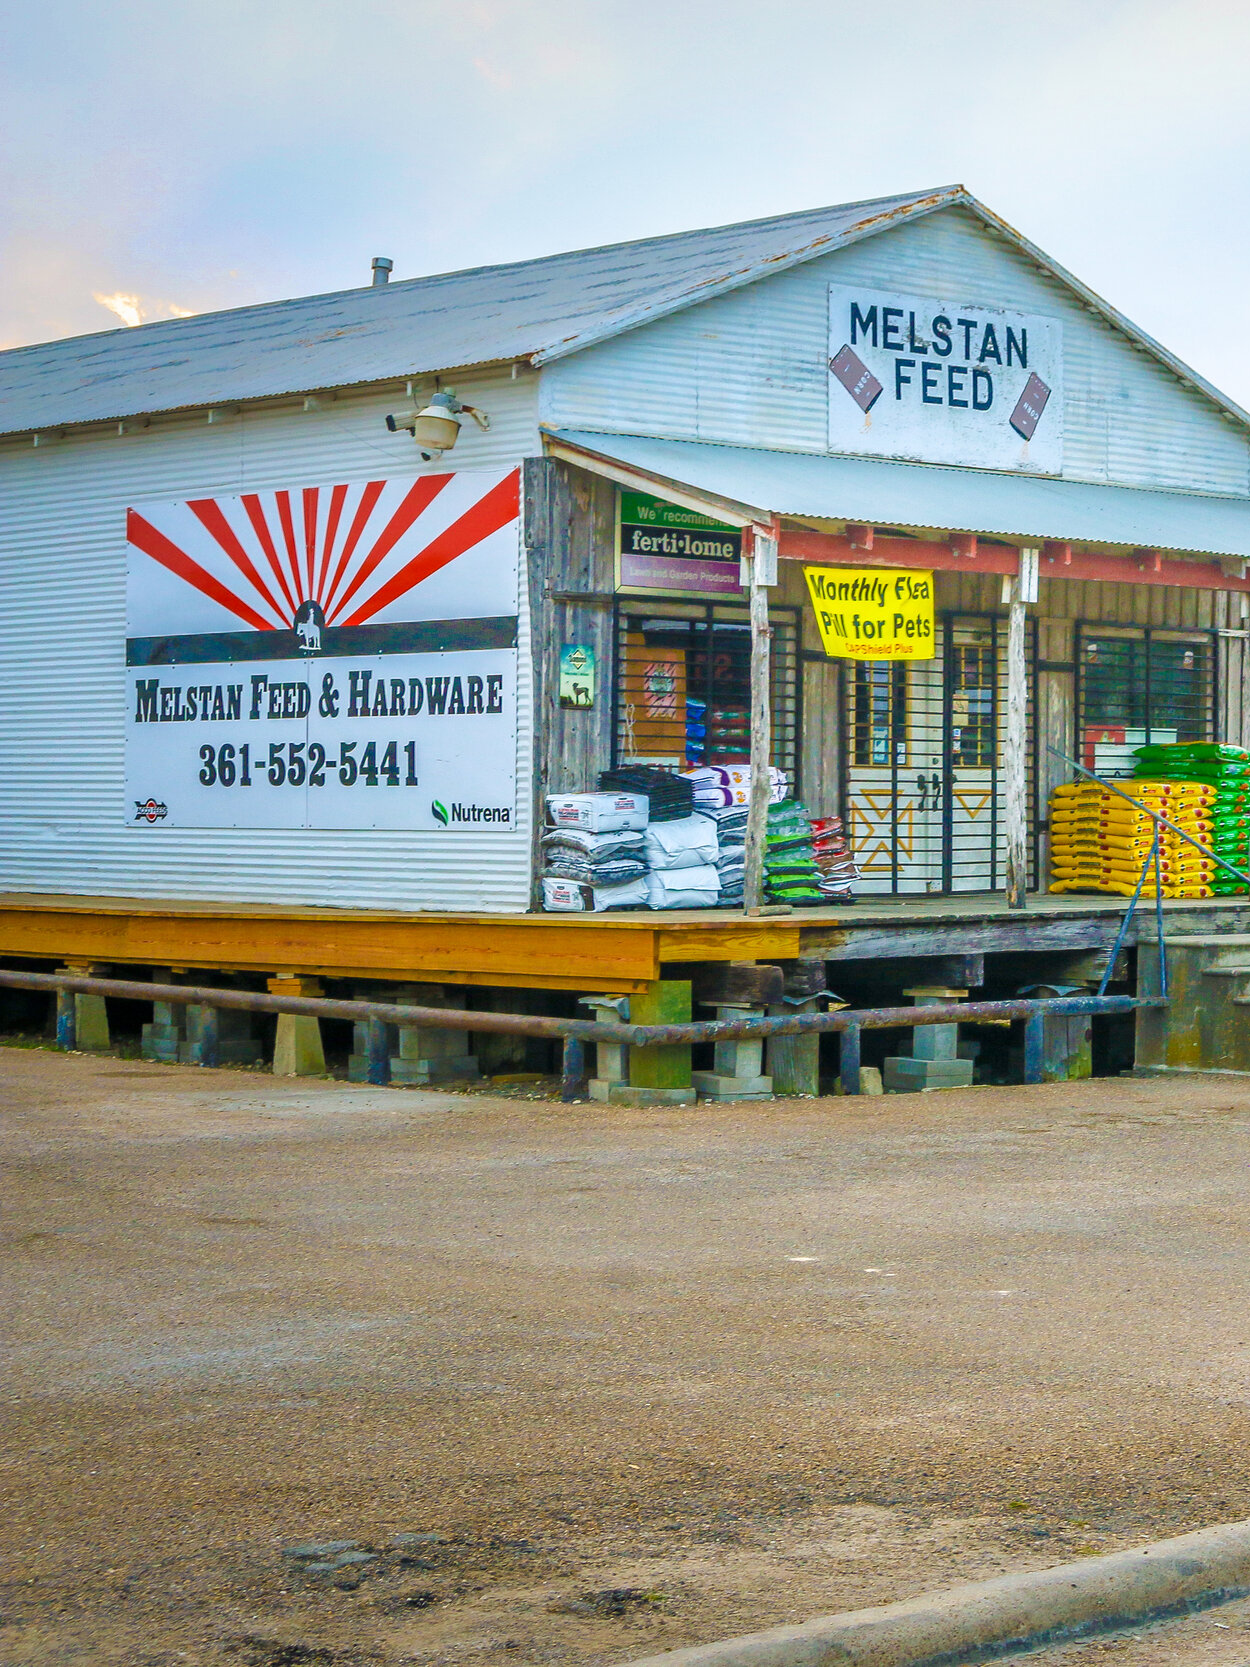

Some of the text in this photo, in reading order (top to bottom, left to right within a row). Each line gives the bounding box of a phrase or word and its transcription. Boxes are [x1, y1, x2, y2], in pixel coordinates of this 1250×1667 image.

[850, 302, 1028, 369] MELSTAN
[854, 371, 871, 395] CORN
[895, 358, 994, 411] FEED
[1023, 402, 1039, 421] CORN
[637, 506, 731, 527] We recommen
[669, 569, 698, 581] Garden
[701, 572, 735, 583] Products
[810, 575, 930, 607] Monthly Flea
[820, 611, 930, 639] Pill for Pets
[895, 643, 913, 654] Plus
[135, 670, 503, 723] MELSTAN FEED & HARDWARE
[199, 741, 419, 788] 361-552-5441
[451, 802, 510, 823] Nutrena
